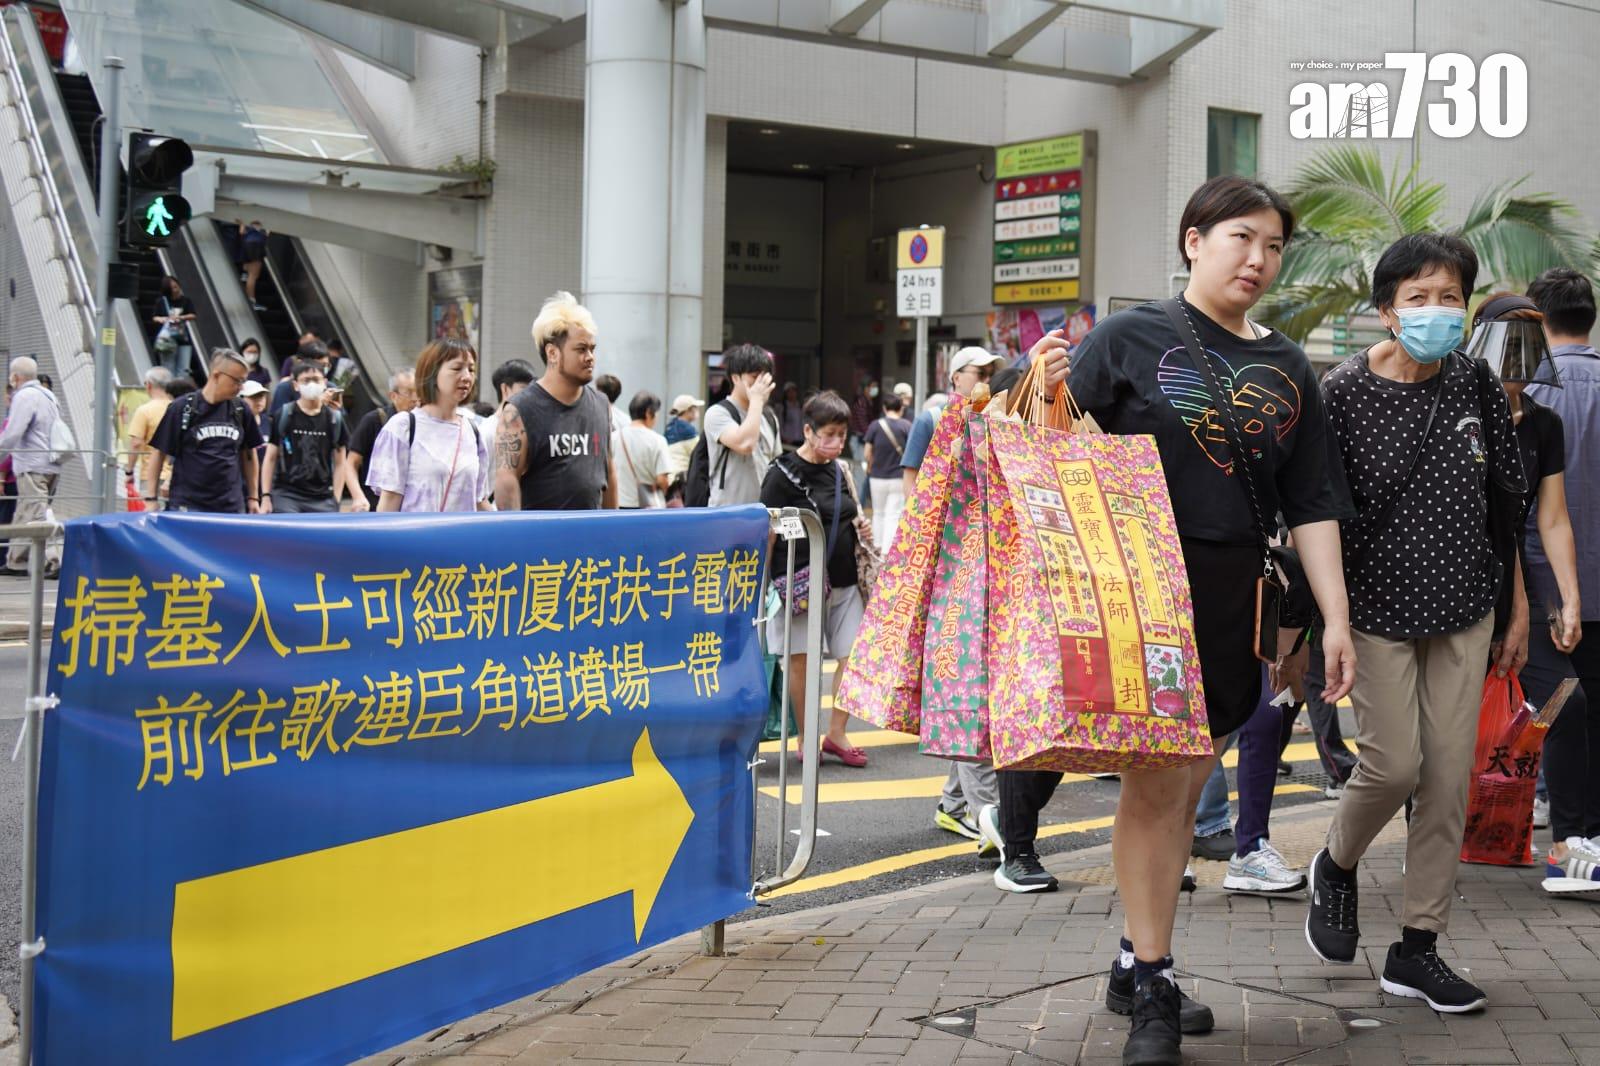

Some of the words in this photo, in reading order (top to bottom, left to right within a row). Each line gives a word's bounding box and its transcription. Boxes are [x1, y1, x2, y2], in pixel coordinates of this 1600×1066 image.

[902, 275, 916, 288] 24
[918, 275, 936, 288] hrs
[905, 293, 931, 310] 全日
[549, 433, 590, 457] KSCY
[57, 549, 760, 678] 掃墓人士可經新廈街扶手電梯
[135, 631, 723, 791] 前往歌連臣角道墳場一帶
